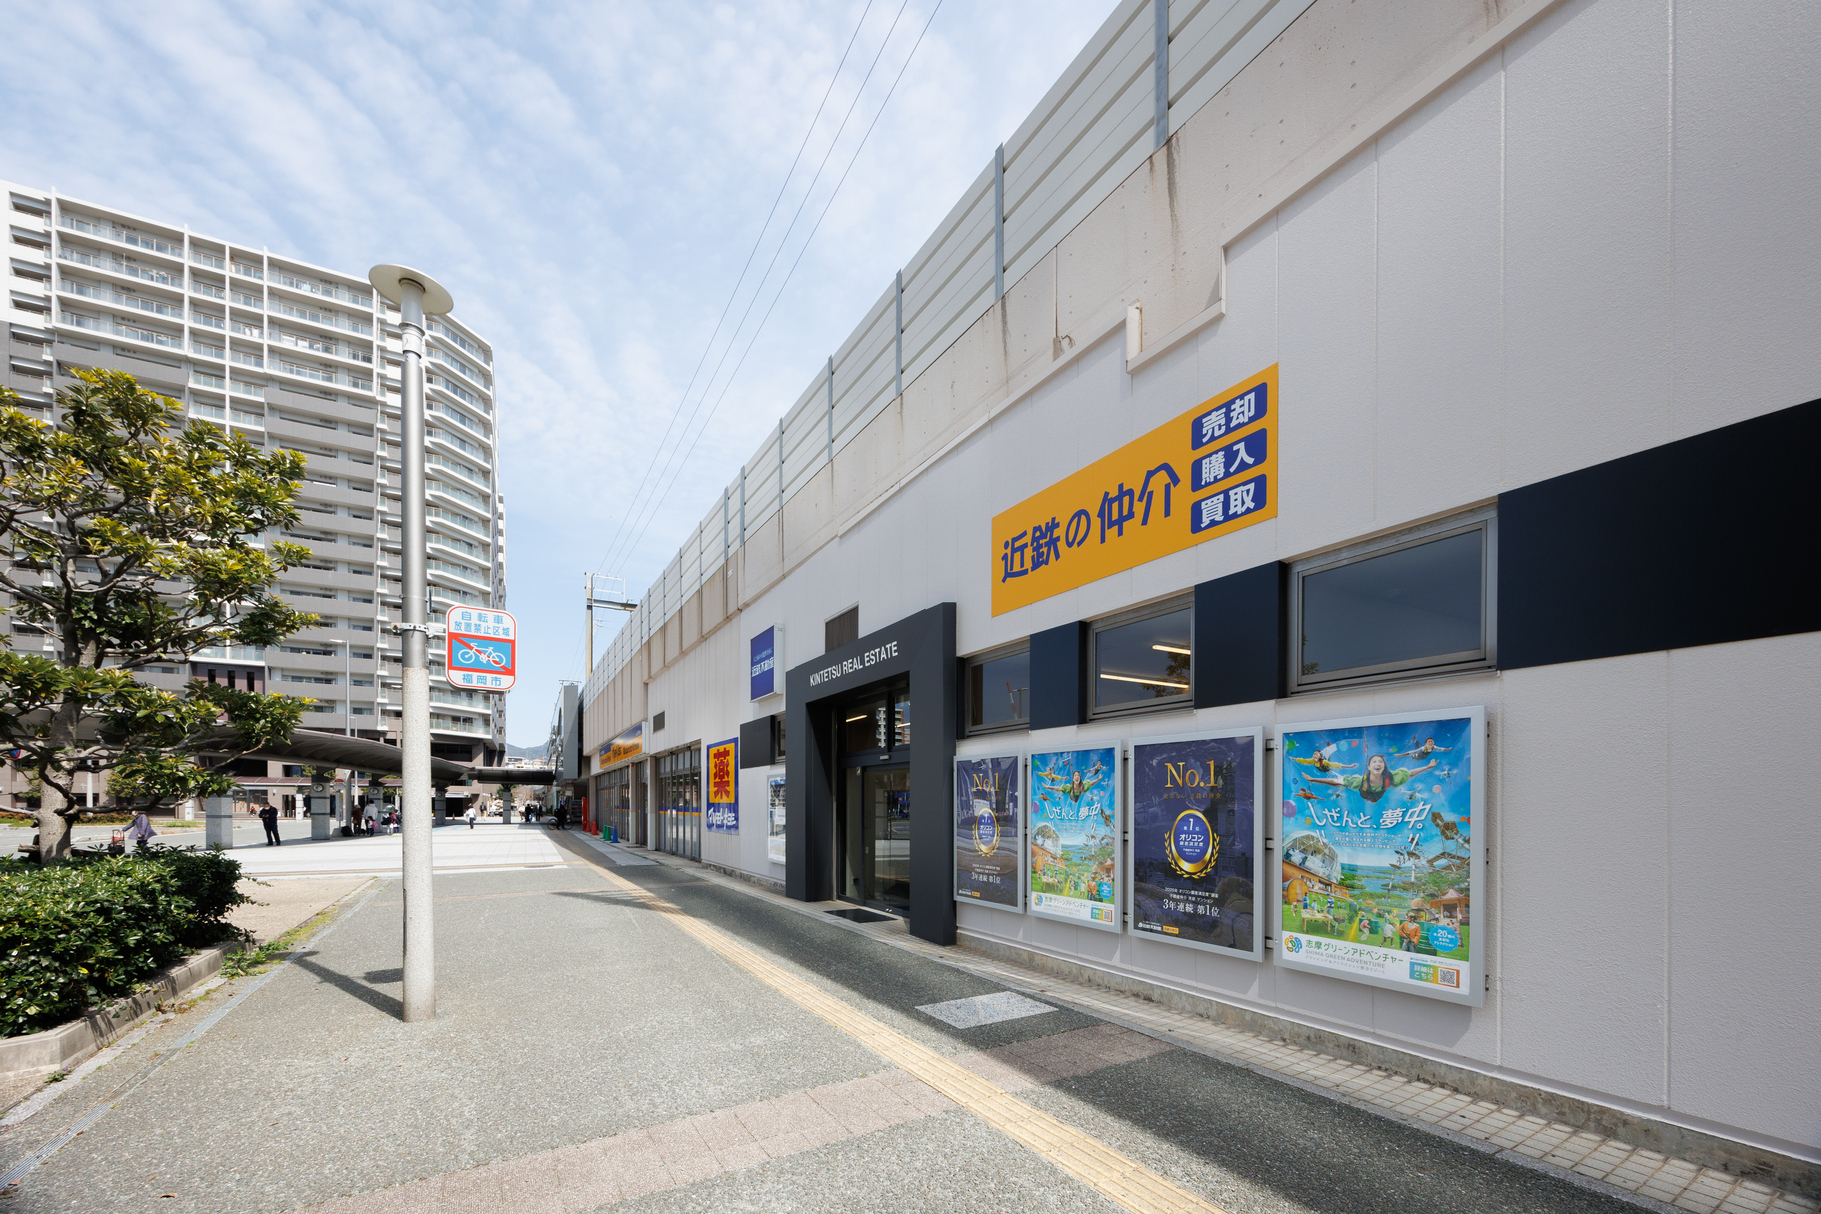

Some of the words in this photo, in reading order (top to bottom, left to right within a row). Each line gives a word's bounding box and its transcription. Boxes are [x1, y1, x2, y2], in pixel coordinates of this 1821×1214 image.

[1202, 391, 1255, 444] 売却
[1201, 442, 1255, 486] 購入
[1200, 482, 1255, 528] 買取
[1001, 462, 1181, 584] 近鉄の仲介
[454, 621, 510, 637] 放置禁止区域
[462, 611, 504, 624] 自転車
[810, 664, 841, 687] KINTETSU
[842, 656, 863, 675] REAL
[864, 641, 898, 667] ESTATE
[462, 674, 502, 686] 福岡市
[714, 747, 730, 800] 薬
[972, 772, 1000, 792] No.1
[1165, 760, 1218, 788] No.1
[1308, 801, 1432, 829] しぜんと、夢中。
[1163, 898, 1194, 913] 3年連続
[1197, 904, 1220, 917] 第1位
[1305, 950, 1324, 958] SHIMA
[1325, 953, 1345, 961] GREEN
[1346, 956, 1385, 968] ADVENTURE
[1306, 939, 1404, 964] 志摩グリーンアドベンチャー
[1414, 972, 1433, 980] こちら
